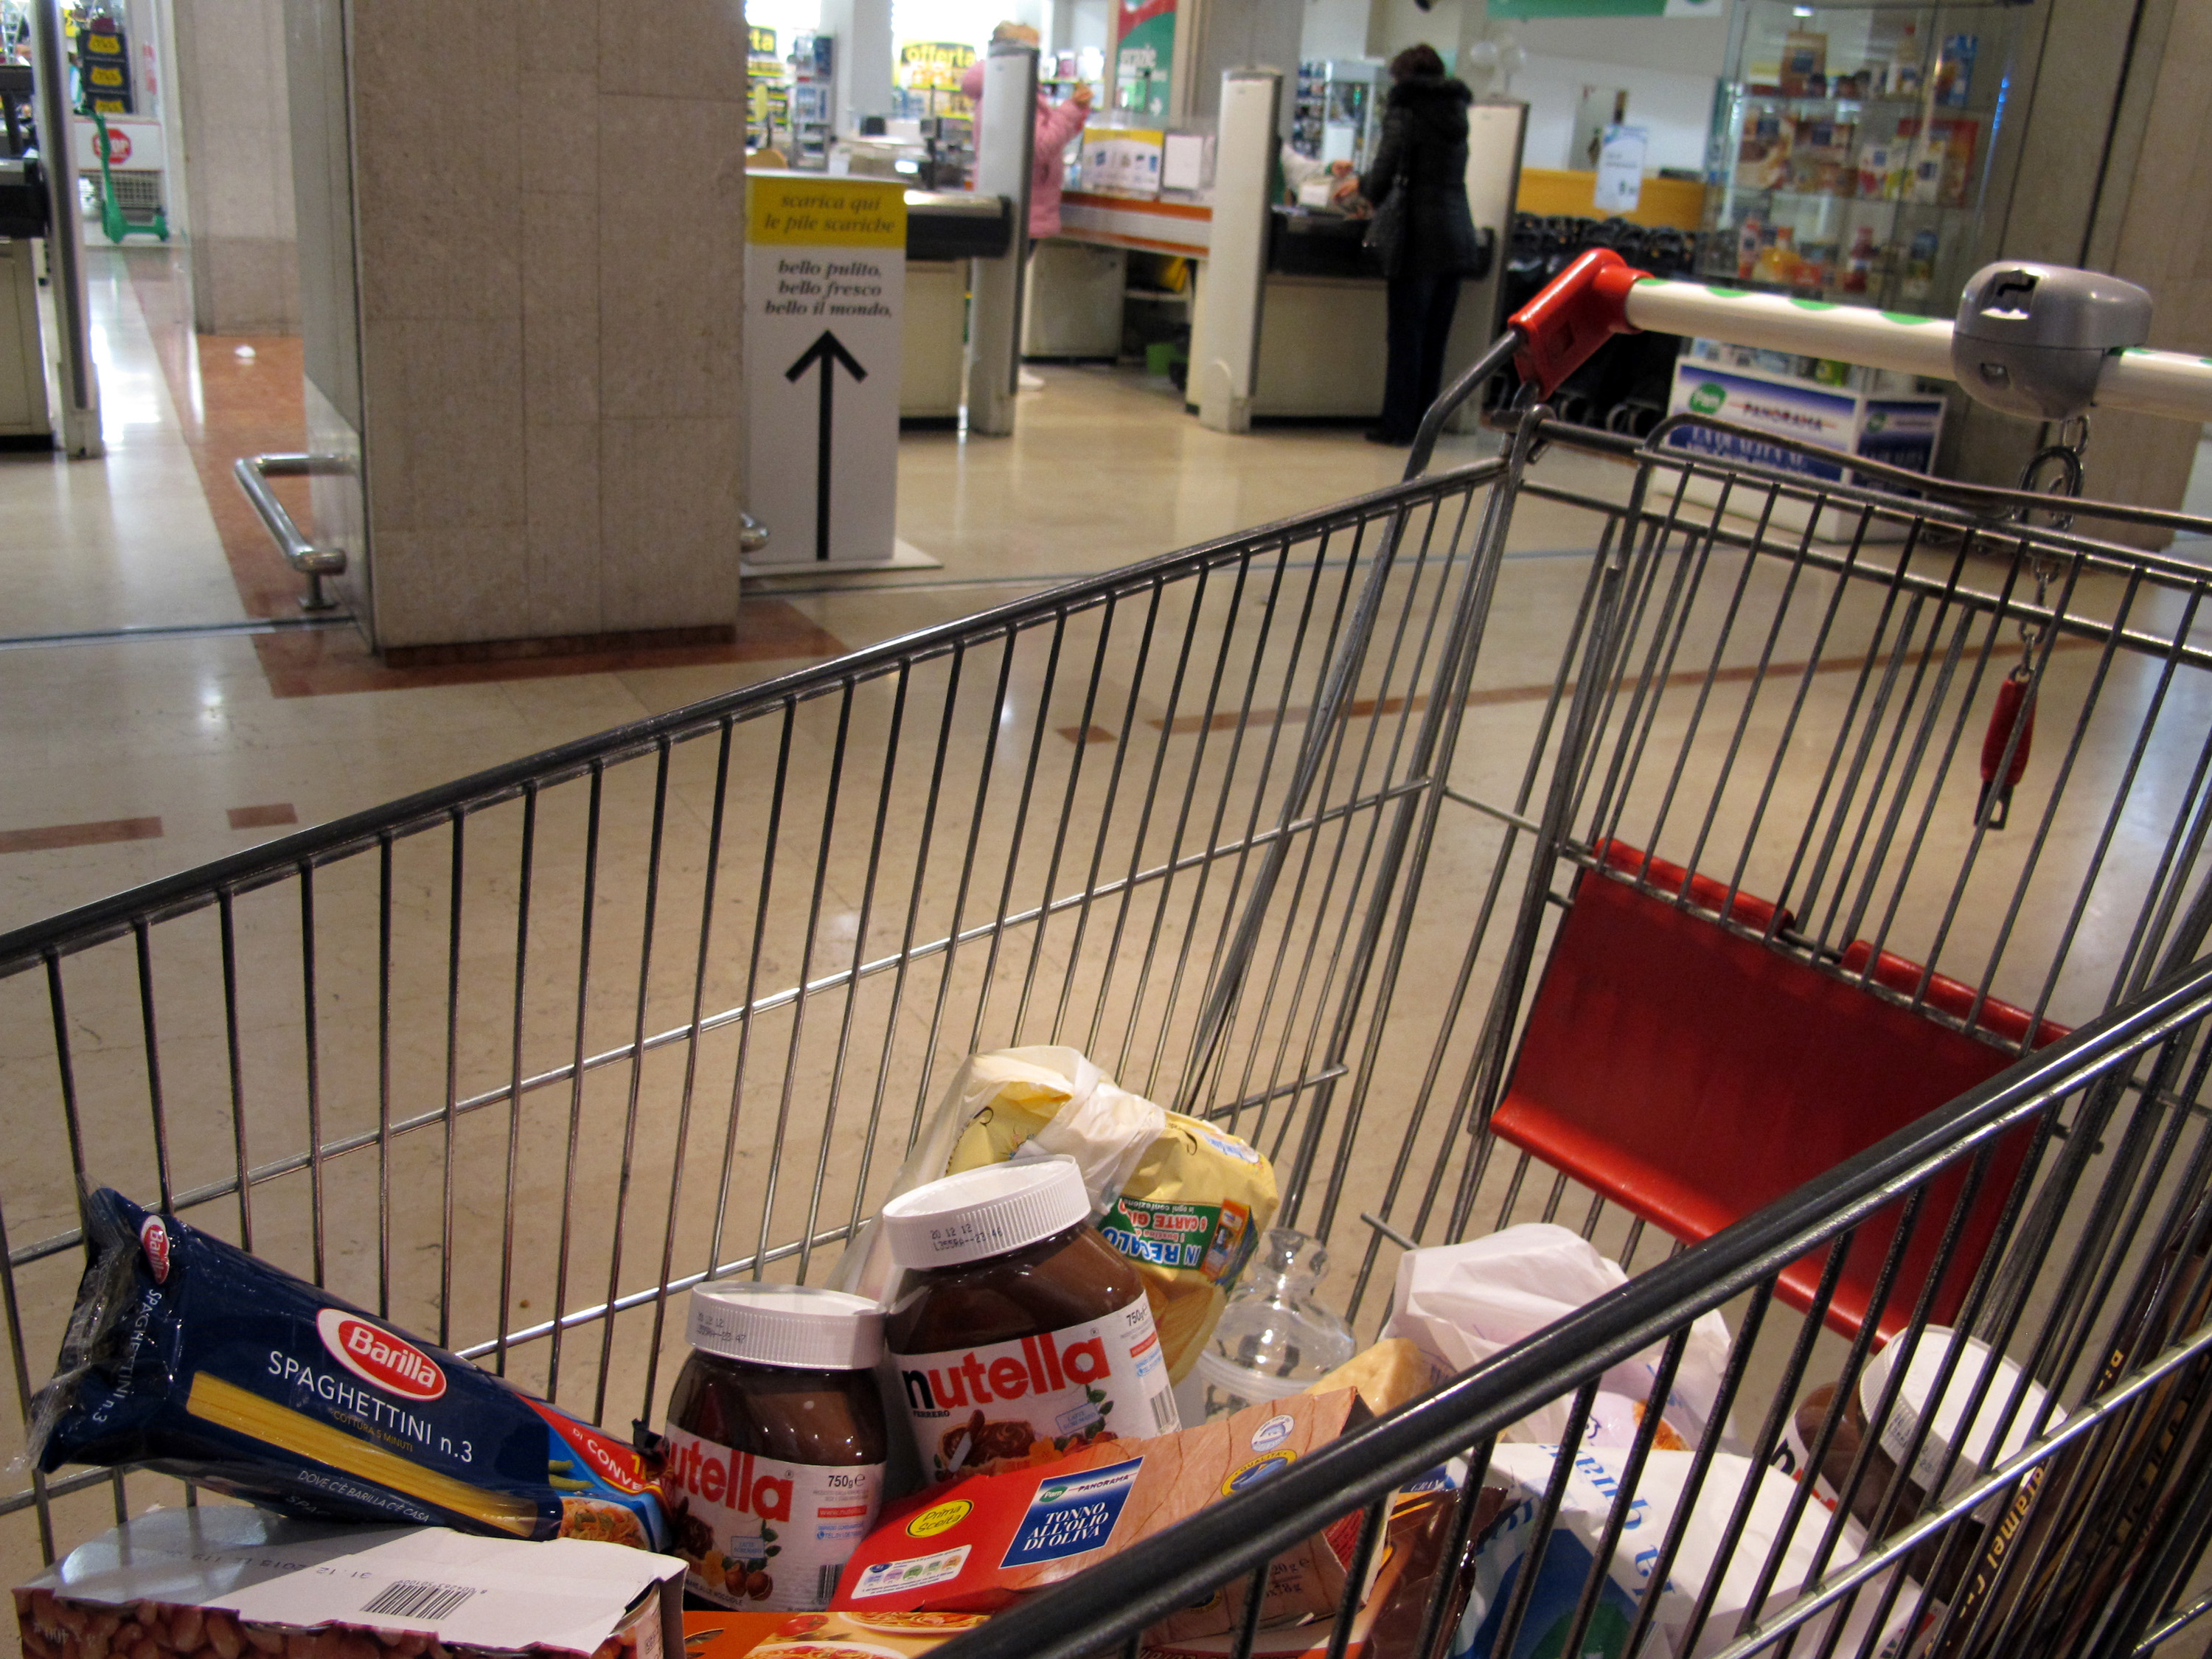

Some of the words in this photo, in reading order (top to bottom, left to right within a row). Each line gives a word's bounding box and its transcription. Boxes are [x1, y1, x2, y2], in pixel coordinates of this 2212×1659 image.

[905, 44, 976, 67] offerta
[782, 196, 844, 209] scarica
[851, 198, 880, 215] qui
[765, 214, 780, 229] le
[785, 215, 818, 234] pile
[825, 218, 895, 232] scariche
[779, 260, 821, 275] bello
[779, 279, 821, 294] bello
[765, 300, 807, 315] bello
[813, 301, 826, 315] il
[946, 1227, 956, 1237] 12
[961, 1224, 973, 1234] 12
[1154, 1214, 1198, 1231] CARTE
[149, 1228, 164, 1279] Barilla
[1184, 1245, 1202, 1266] IN
[347, 1326, 437, 1388] Barilla
[902, 1332, 1111, 1409] nutella
[268, 1350, 432, 1444] SPAGHETTINI
[441, 1436, 473, 1463] n.3
[913, 1409, 950, 1418] FERRERO
[333, 1411, 375, 1433] COTTURA
[376, 1429, 383, 1439] 5
[383, 1433, 413, 1453] MINUTI
[573, 1427, 583, 1440] DI
[587, 1439, 660, 1490] CONVE
[669, 1441, 794, 1522] utella
[1044, 1490, 1062, 1498] Pam
[1078, 1475, 1129, 1492] PANORAMA
[298, 1470, 329, 1489] DOVE
[348, 1486, 386, 1509] BARILLA
[403, 1506, 430, 1523] CASA
[916, 1514, 961, 1533] Scelta
[922, 1505, 962, 1522] Prima
[1046, 1502, 1106, 1525] TONNO
[1986, 1462, 2048, 1569] aramel
[1027, 1512, 1110, 1540] ALL'OLIO
[1023, 1537, 1045, 1551] DI
[1048, 1526, 1101, 1546] OLIVA
